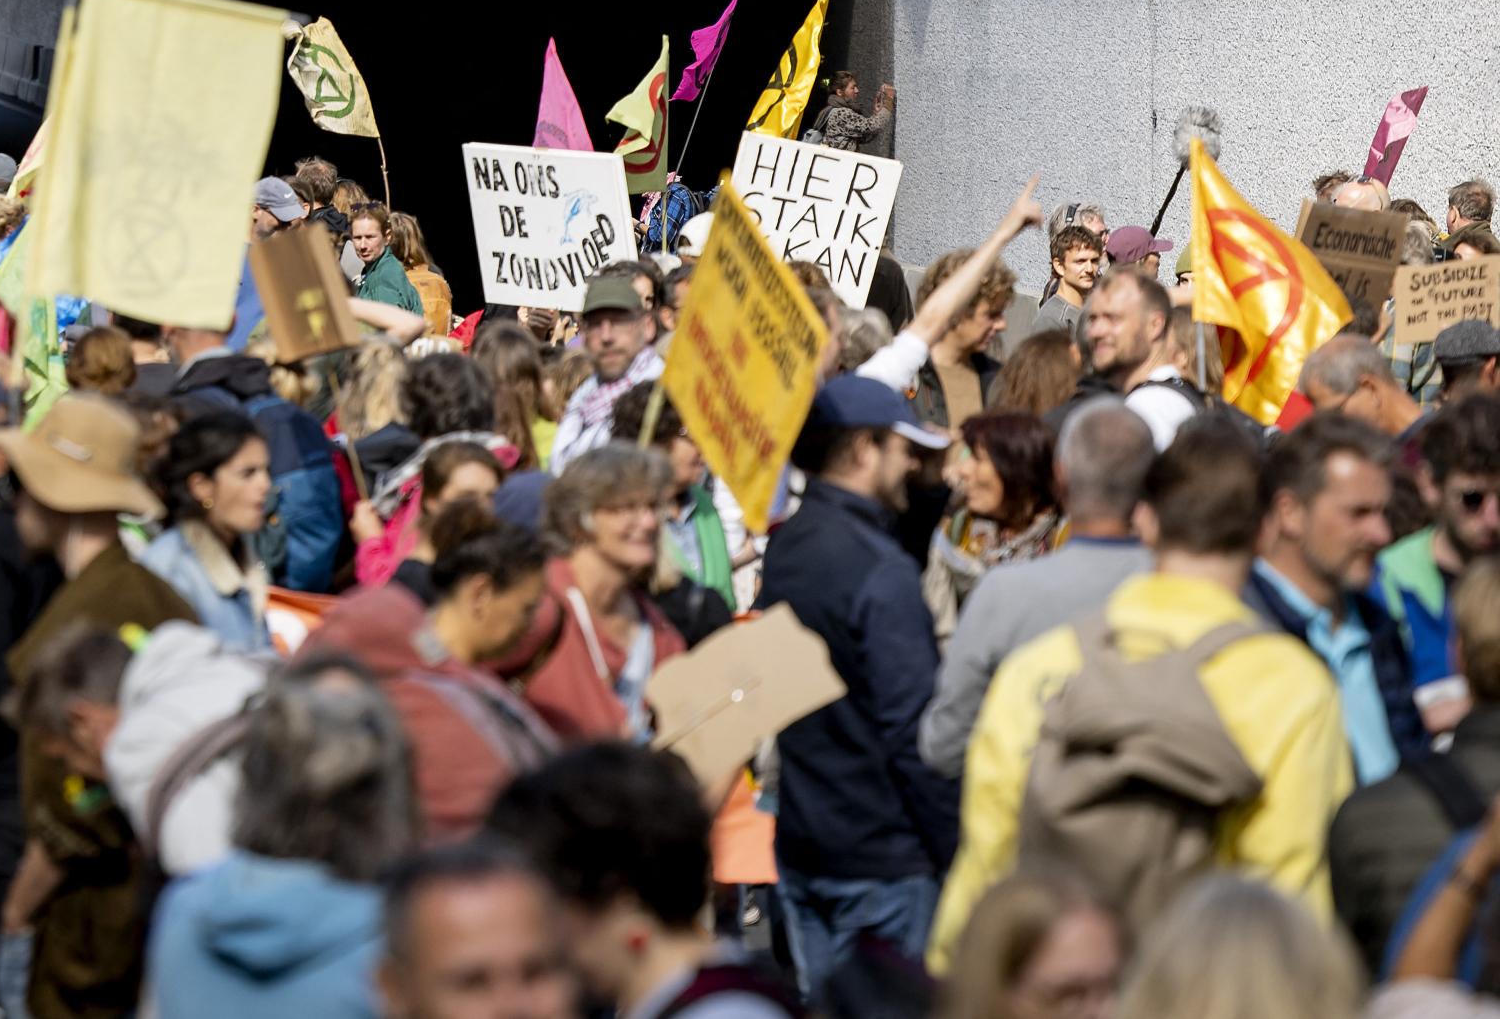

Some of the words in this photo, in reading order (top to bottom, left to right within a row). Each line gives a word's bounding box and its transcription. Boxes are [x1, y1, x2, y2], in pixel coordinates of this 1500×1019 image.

[472, 157, 509, 192] NA
[750, 143, 879, 209] HIER
[498, 204, 529, 239] DE
[742, 191, 820, 239] STA
[1410, 264, 1488, 292] SUBSIDIZE
[1407, 310, 1428, 325] NOT
